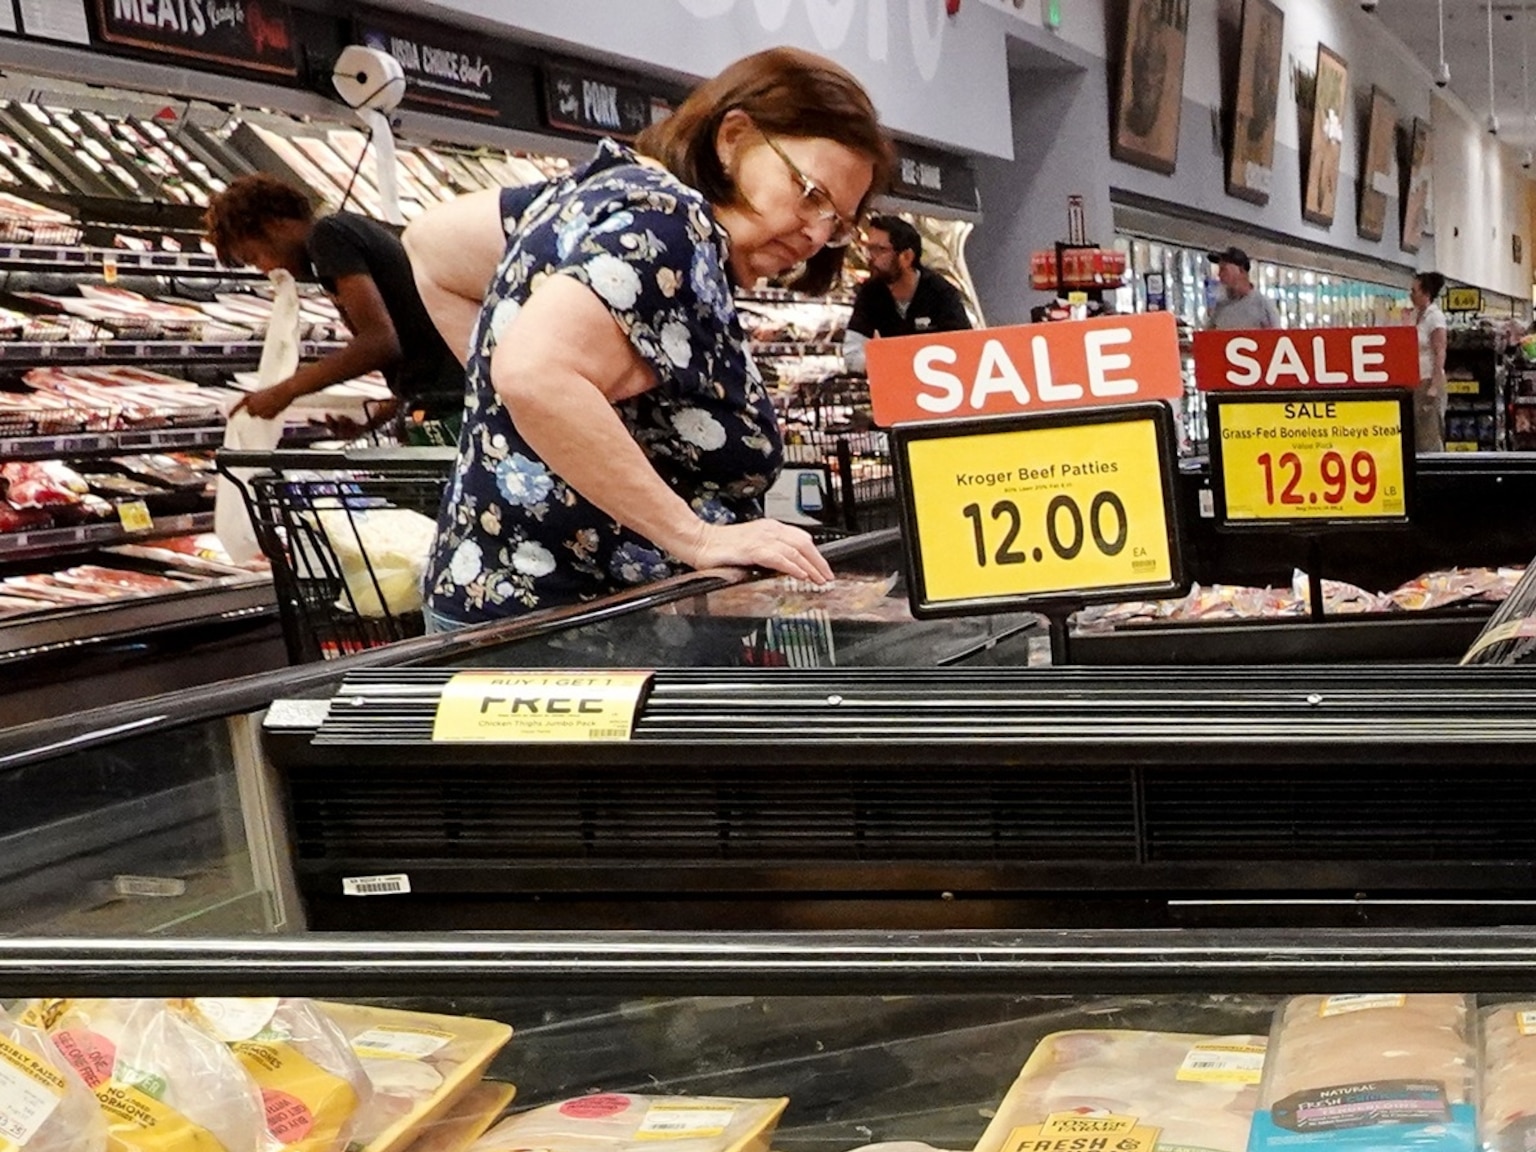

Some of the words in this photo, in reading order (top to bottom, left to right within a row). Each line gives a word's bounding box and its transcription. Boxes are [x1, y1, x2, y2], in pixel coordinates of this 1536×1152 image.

[582, 79, 622, 129] PORK
[1224, 334, 1389, 386] SALE
[913, 327, 1139, 413] SALE
[1284, 402, 1337, 419] SALE
[1222, 426, 1277, 439] Grass-Fed
[1280, 426, 1328, 438] Boneless
[1332, 426, 1369, 438] Ribeye
[956, 472, 1012, 487] Kroger
[1019, 464, 1055, 481] Beef
[1061, 461, 1118, 476] Patties
[1257, 451, 1378, 505] 12.99
[1384, 486, 1397, 496] LB
[963, 490, 1128, 568] 12.00
[1133, 547, 1148, 558] EA
[514, 720, 542, 728] Thighs
[32, 1060, 66, 1089] RAISED
[106, 1086, 126, 1099] NO
[1320, 1083, 1376, 1098] NATURAL
[1298, 1098, 1341, 1111] FRESH
[1016, 1138, 1108, 1152] FRESH
[1116, 1138, 1141, 1151] &
